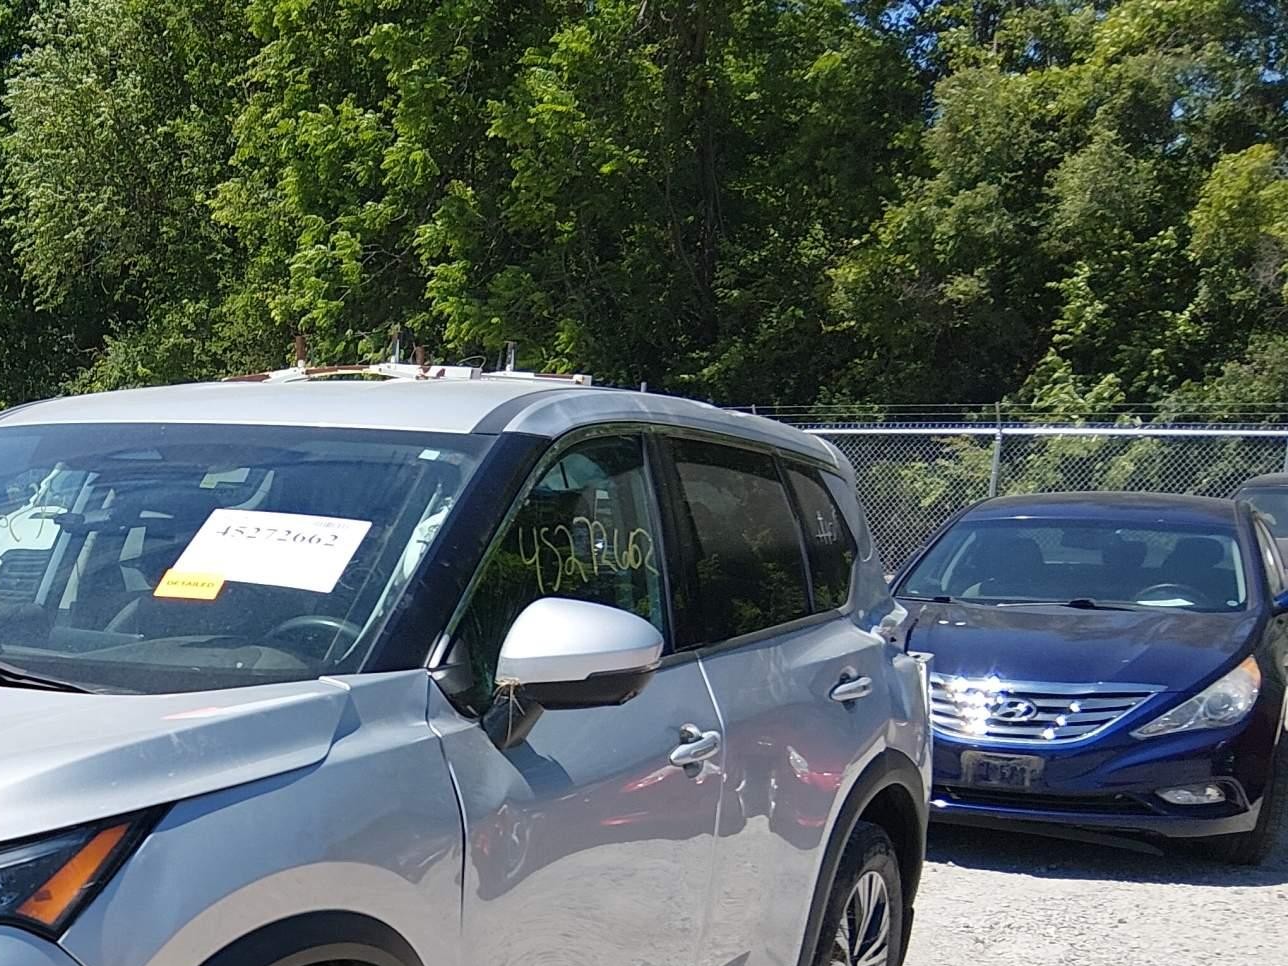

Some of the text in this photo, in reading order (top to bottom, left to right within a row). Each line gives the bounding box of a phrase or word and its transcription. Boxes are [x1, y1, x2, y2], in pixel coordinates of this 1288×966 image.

[215, 525, 339, 547] 45272662
[518, 516, 660, 594] 45272662
[166, 579, 216, 588] DETAILED
